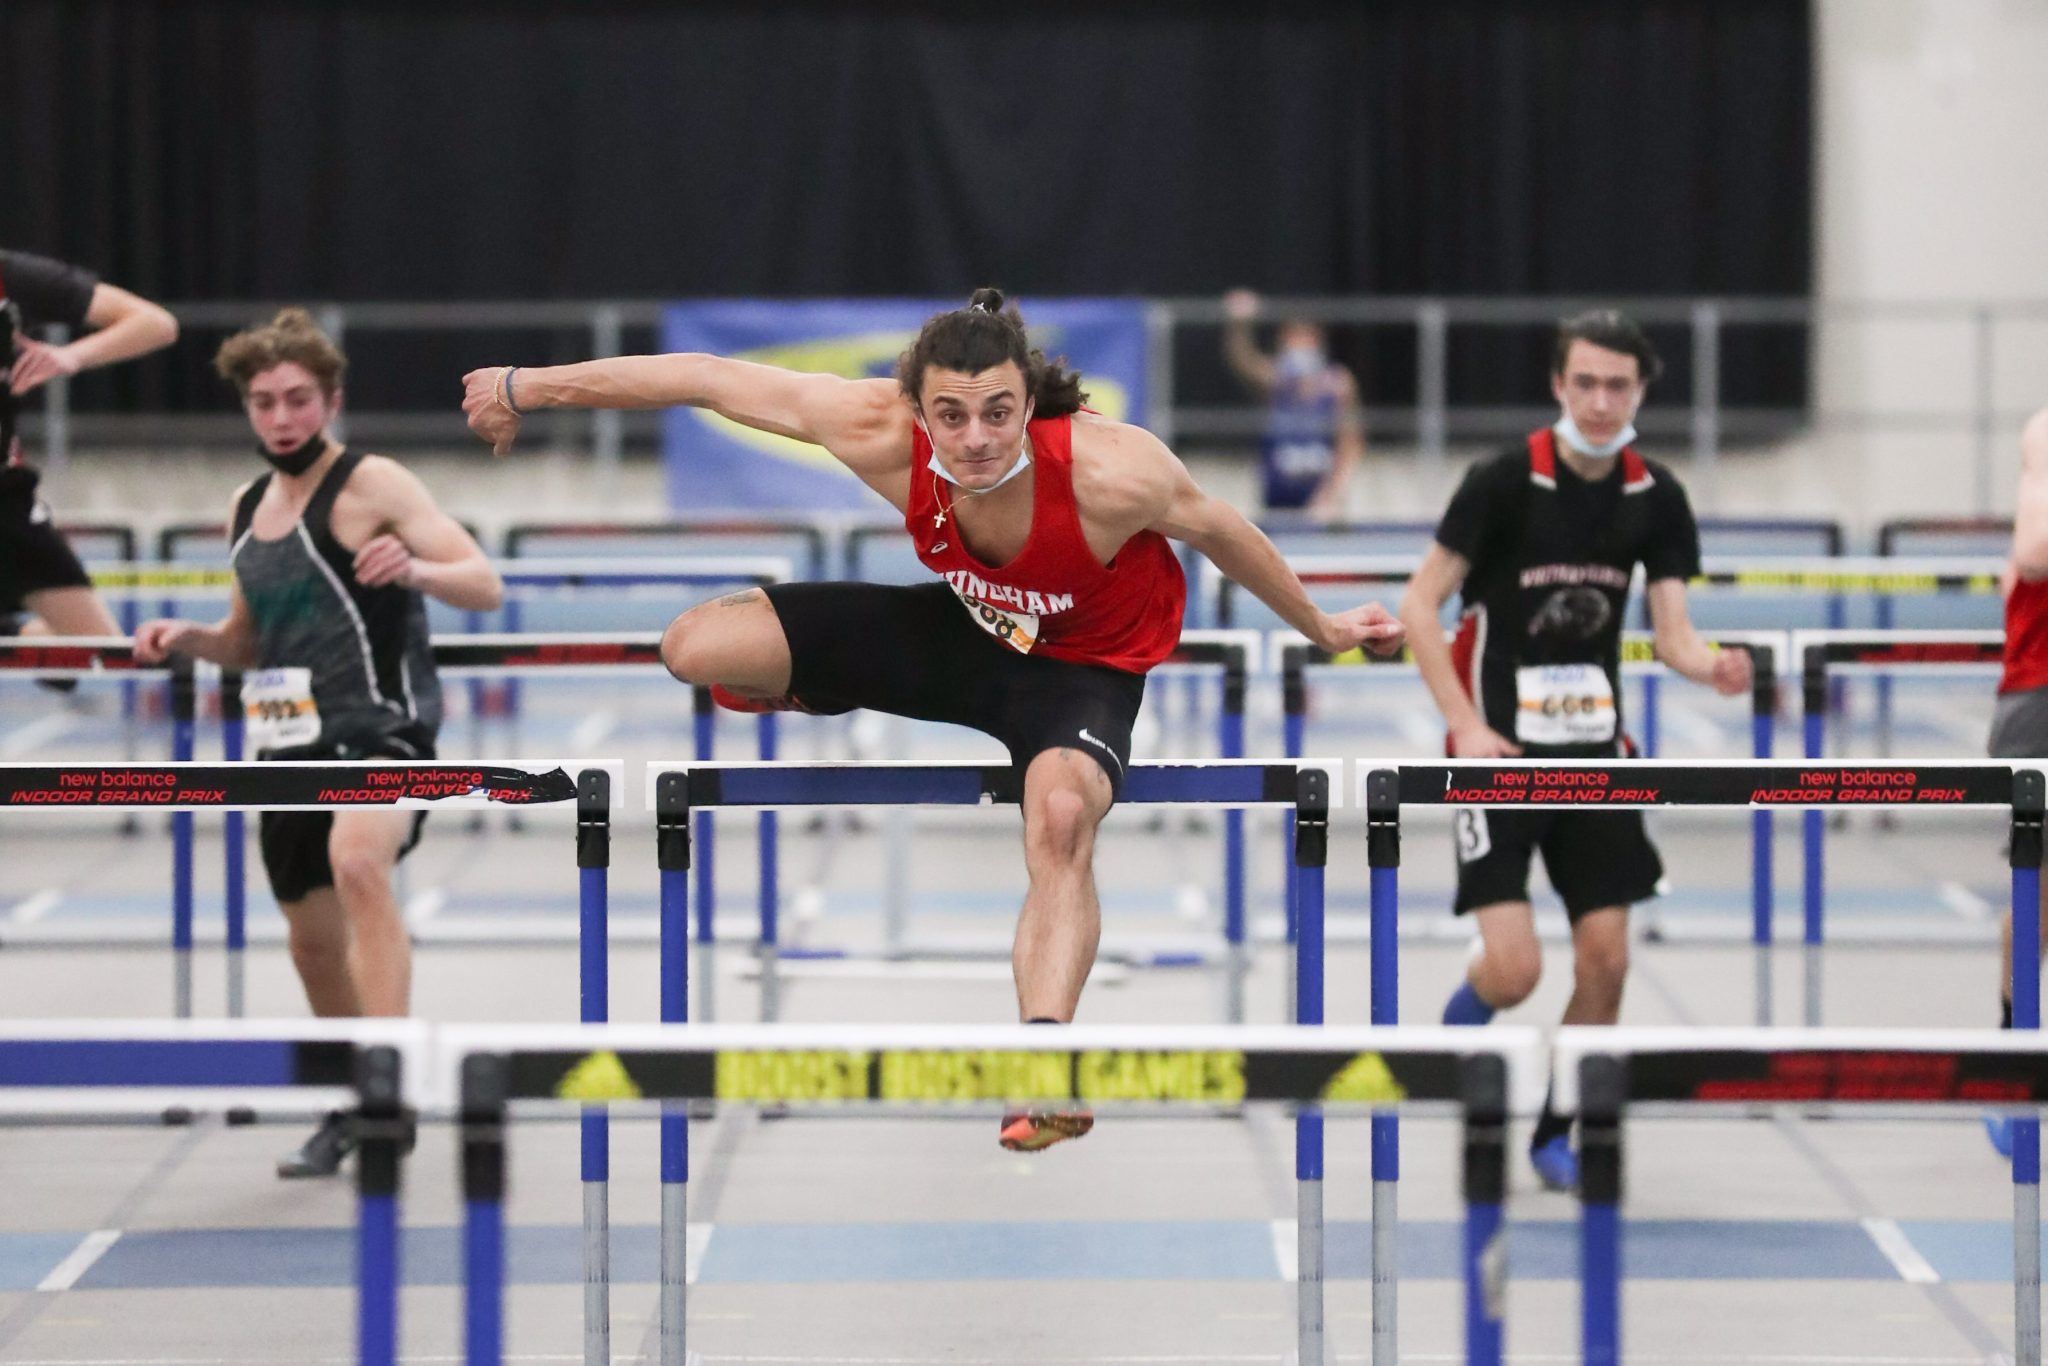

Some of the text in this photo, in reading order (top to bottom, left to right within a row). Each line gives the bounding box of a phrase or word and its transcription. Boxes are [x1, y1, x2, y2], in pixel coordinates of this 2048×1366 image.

[59, 771, 177, 787] new balance
[367, 769, 483, 786] new balance
[1493, 770, 1609, 786] new balance
[1800, 770, 1916, 786] new balance
[11, 790, 226, 803] INDOOR GRAND PRIX
[318, 789, 400, 802] INDOOR
[1444, 789, 1659, 802] INDOOR GRAND PRIX
[1752, 789, 1967, 802] INDOOR GRAND PRIX
